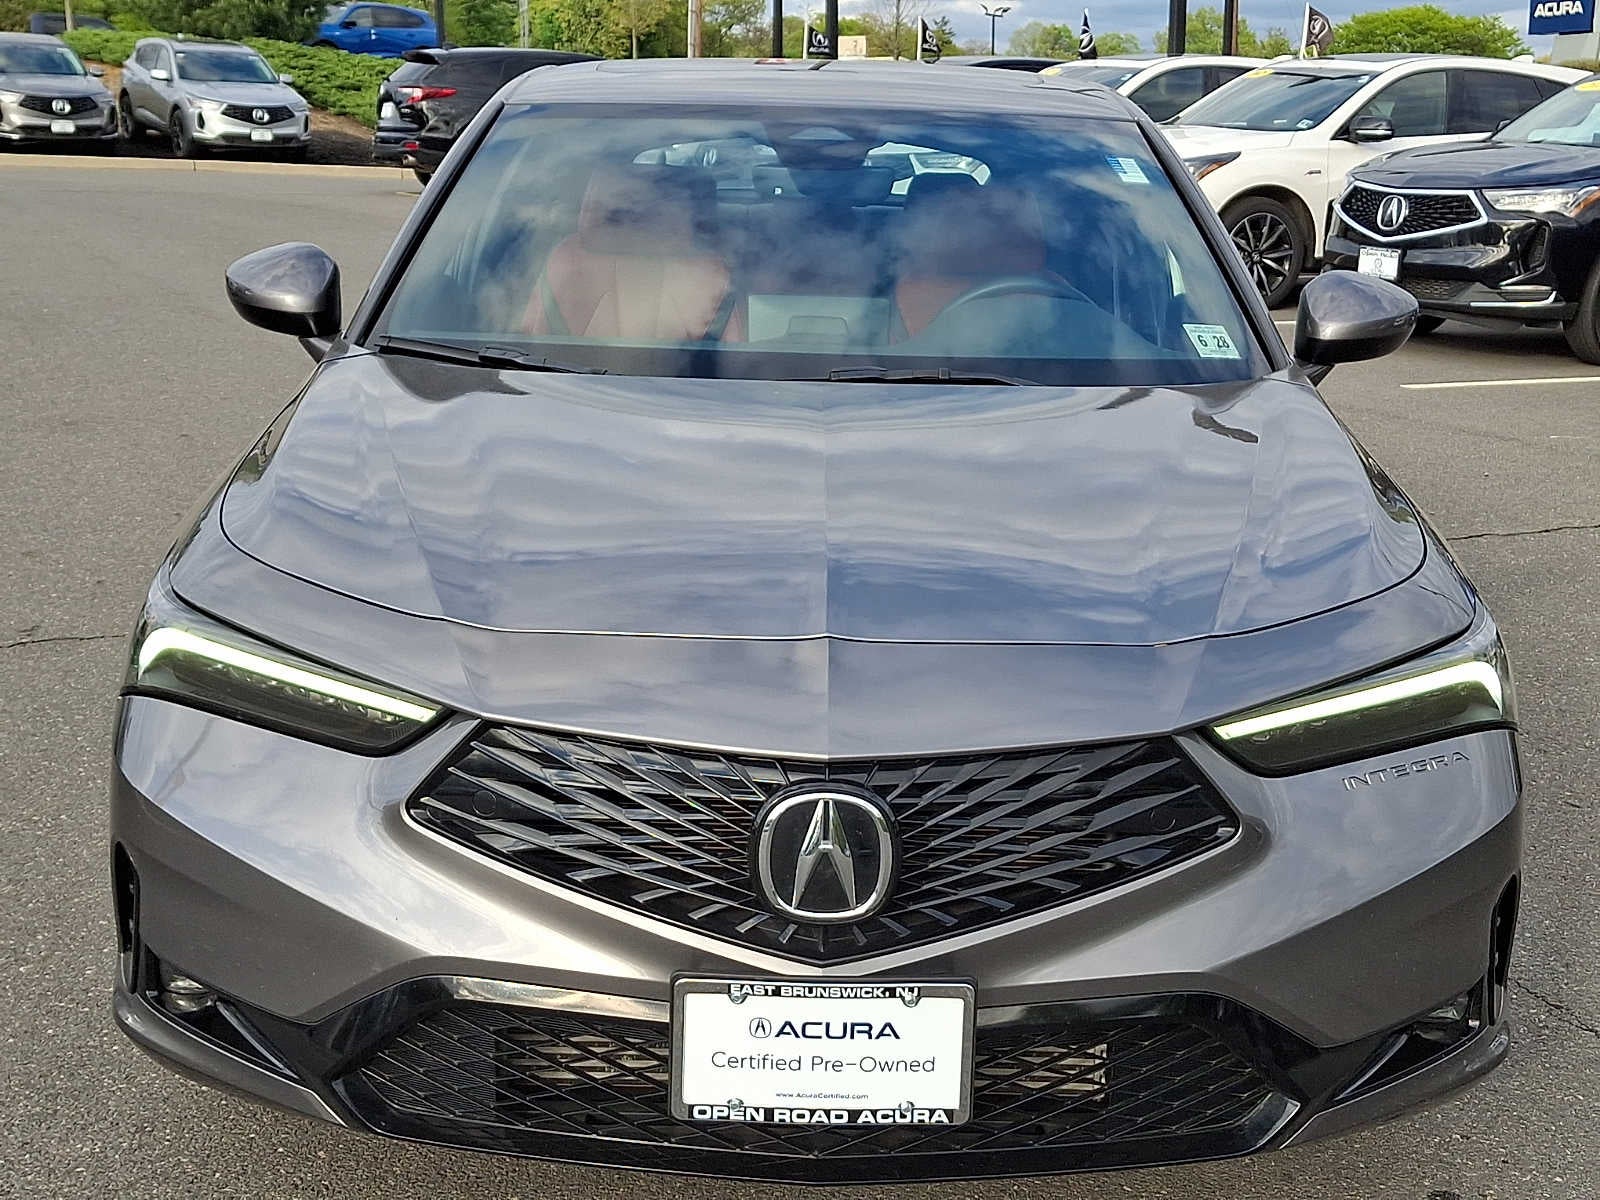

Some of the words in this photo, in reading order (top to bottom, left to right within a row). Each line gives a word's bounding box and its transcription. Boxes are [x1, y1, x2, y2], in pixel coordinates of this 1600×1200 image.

[1534, 1, 1583, 18] ACURA
[1197, 335, 1208, 347] 6
[1342, 751, 1470, 791] INTEGRA
[730, 983, 776, 996] EAST
[774, 1020, 901, 1040] ACURA
[711, 1051, 802, 1071] Certified
[811, 1055, 936, 1073] Pre-Owned
[692, 1105, 765, 1122] OPEN
[773, 1107, 849, 1124] ROAD
[856, 1109, 950, 1124] ACURA
